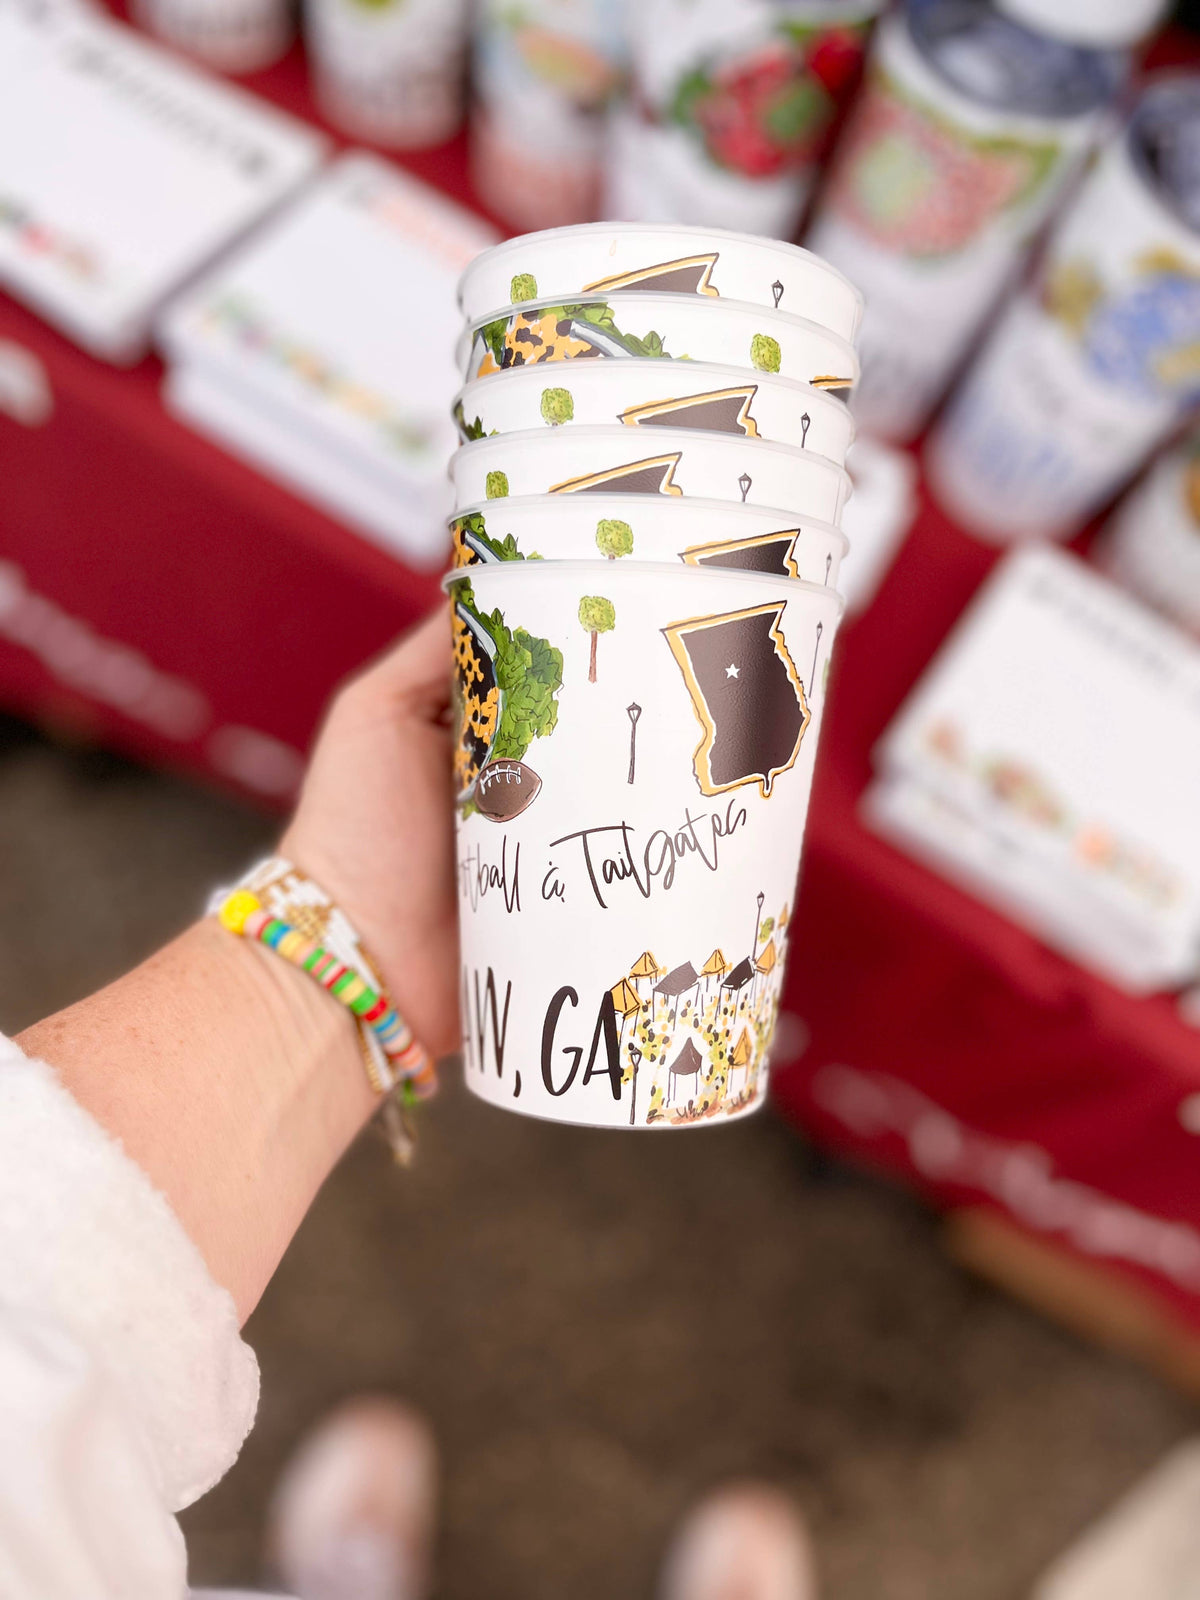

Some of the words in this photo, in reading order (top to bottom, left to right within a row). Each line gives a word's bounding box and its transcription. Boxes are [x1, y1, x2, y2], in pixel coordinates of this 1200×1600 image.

[460, 834, 521, 914] tball
[549, 798, 747, 910] Tailgates
[540, 985, 625, 1101] GA
